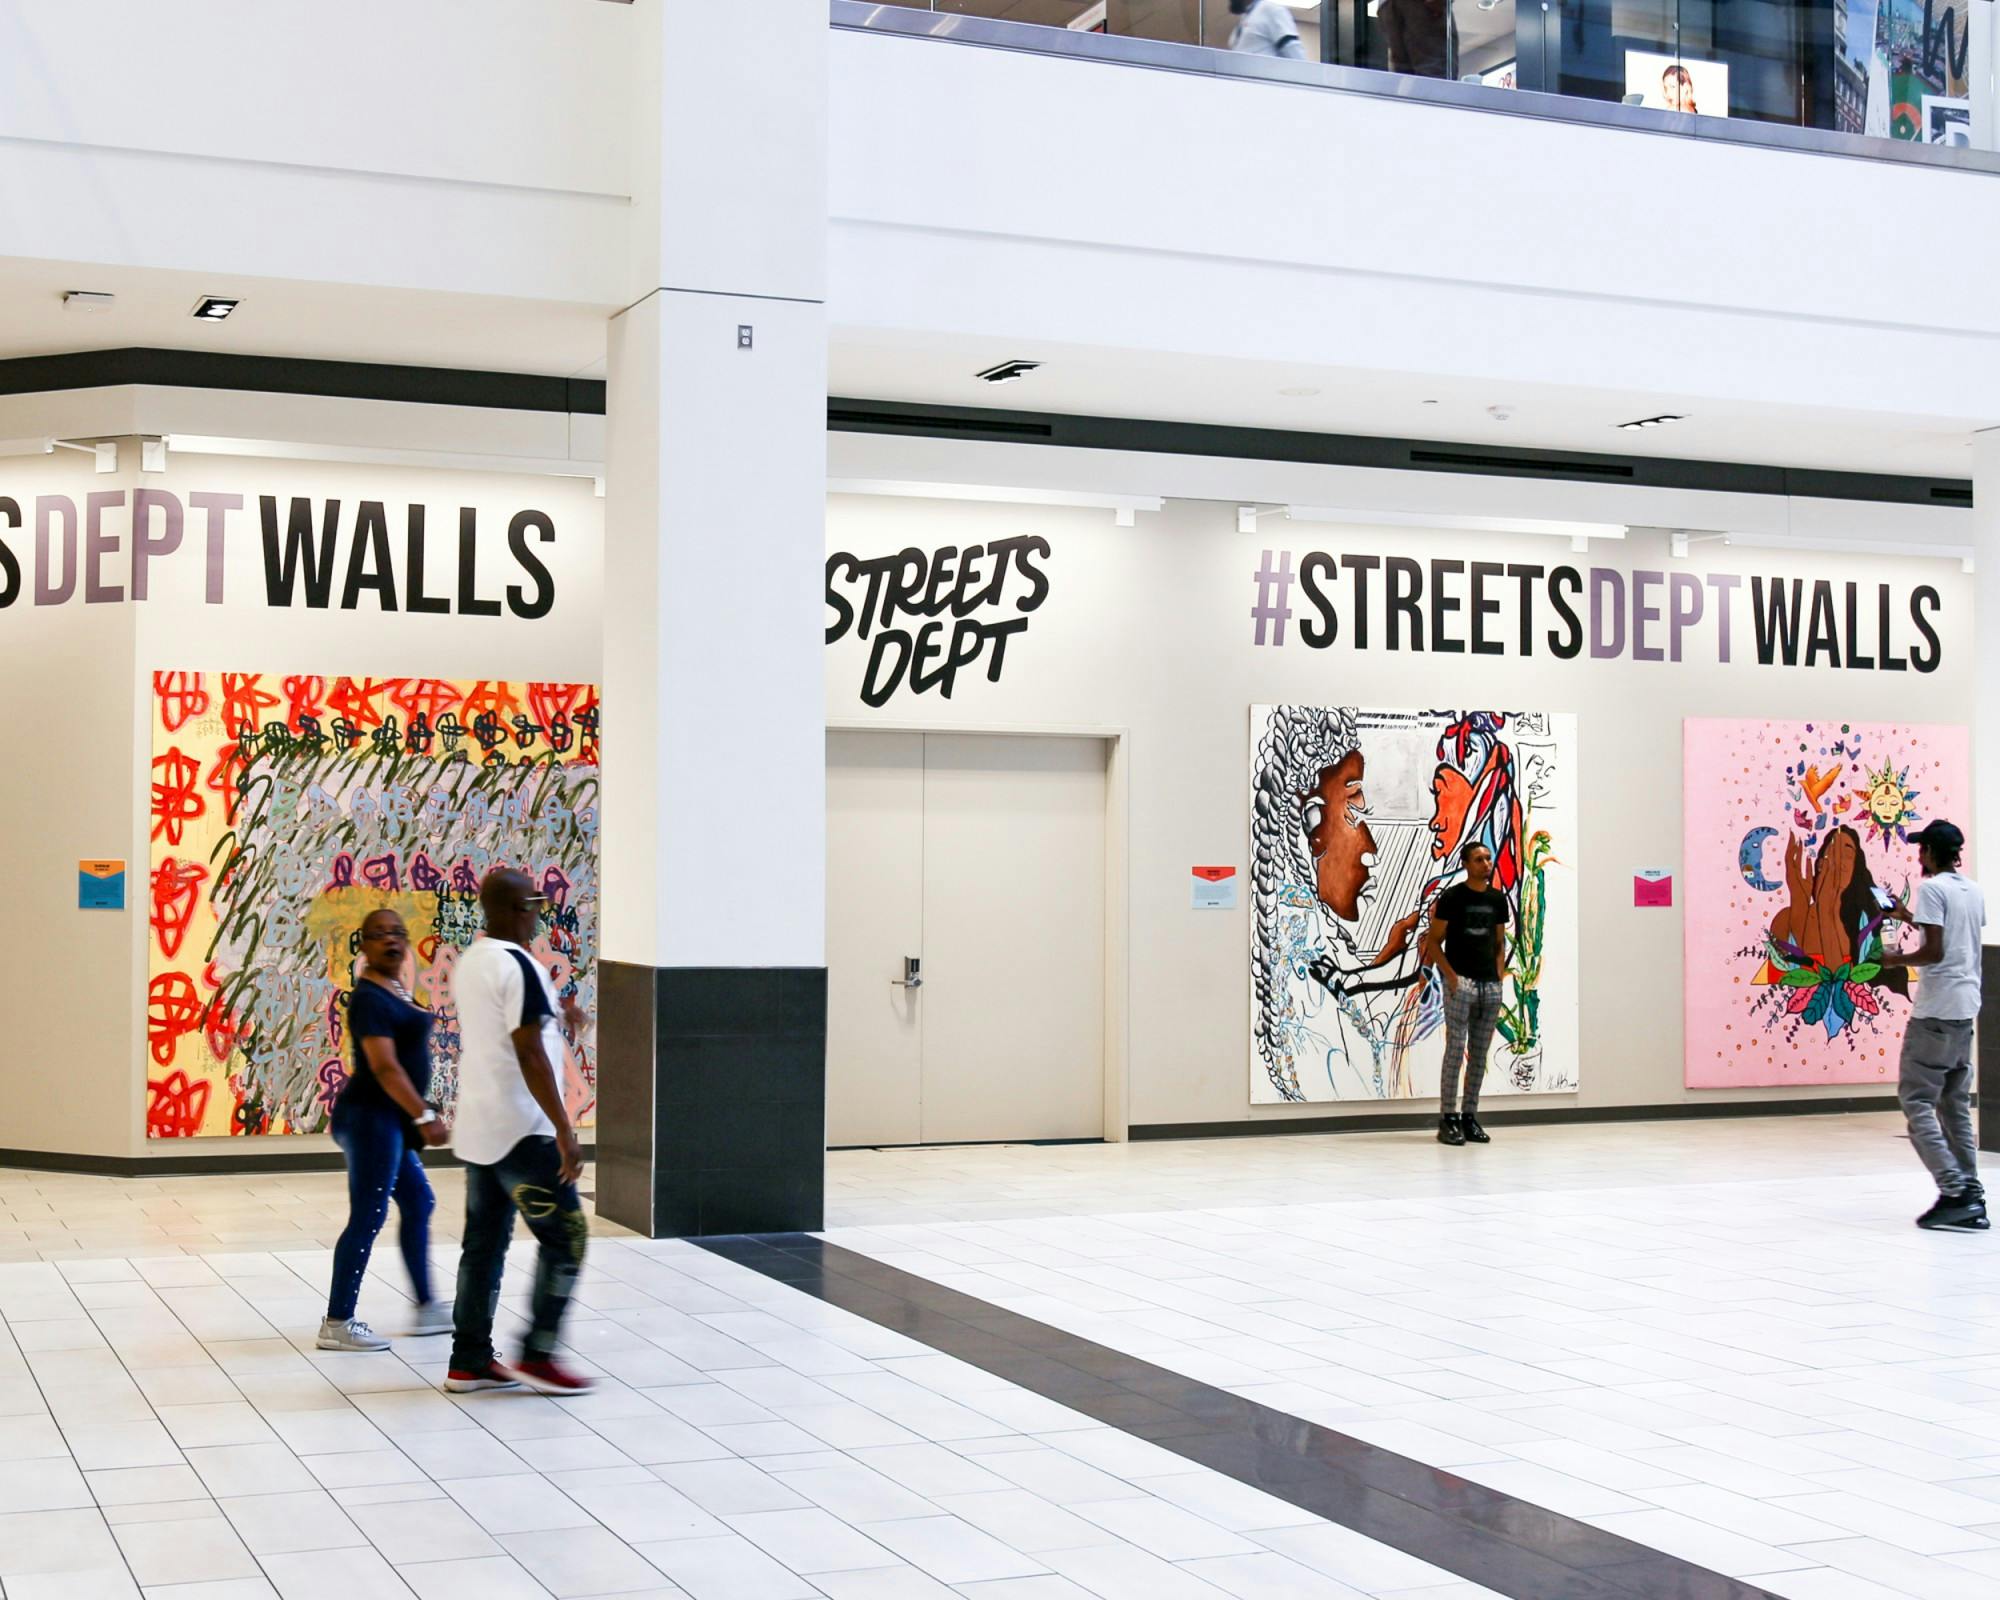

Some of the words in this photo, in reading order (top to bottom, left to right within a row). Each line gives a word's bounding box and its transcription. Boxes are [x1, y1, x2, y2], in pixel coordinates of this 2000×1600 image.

[259, 495, 556, 620] WALLS
[825, 534, 1051, 645] STREETS
[859, 616, 1029, 708] DEPT
[1751, 576, 1942, 673] WALLS
